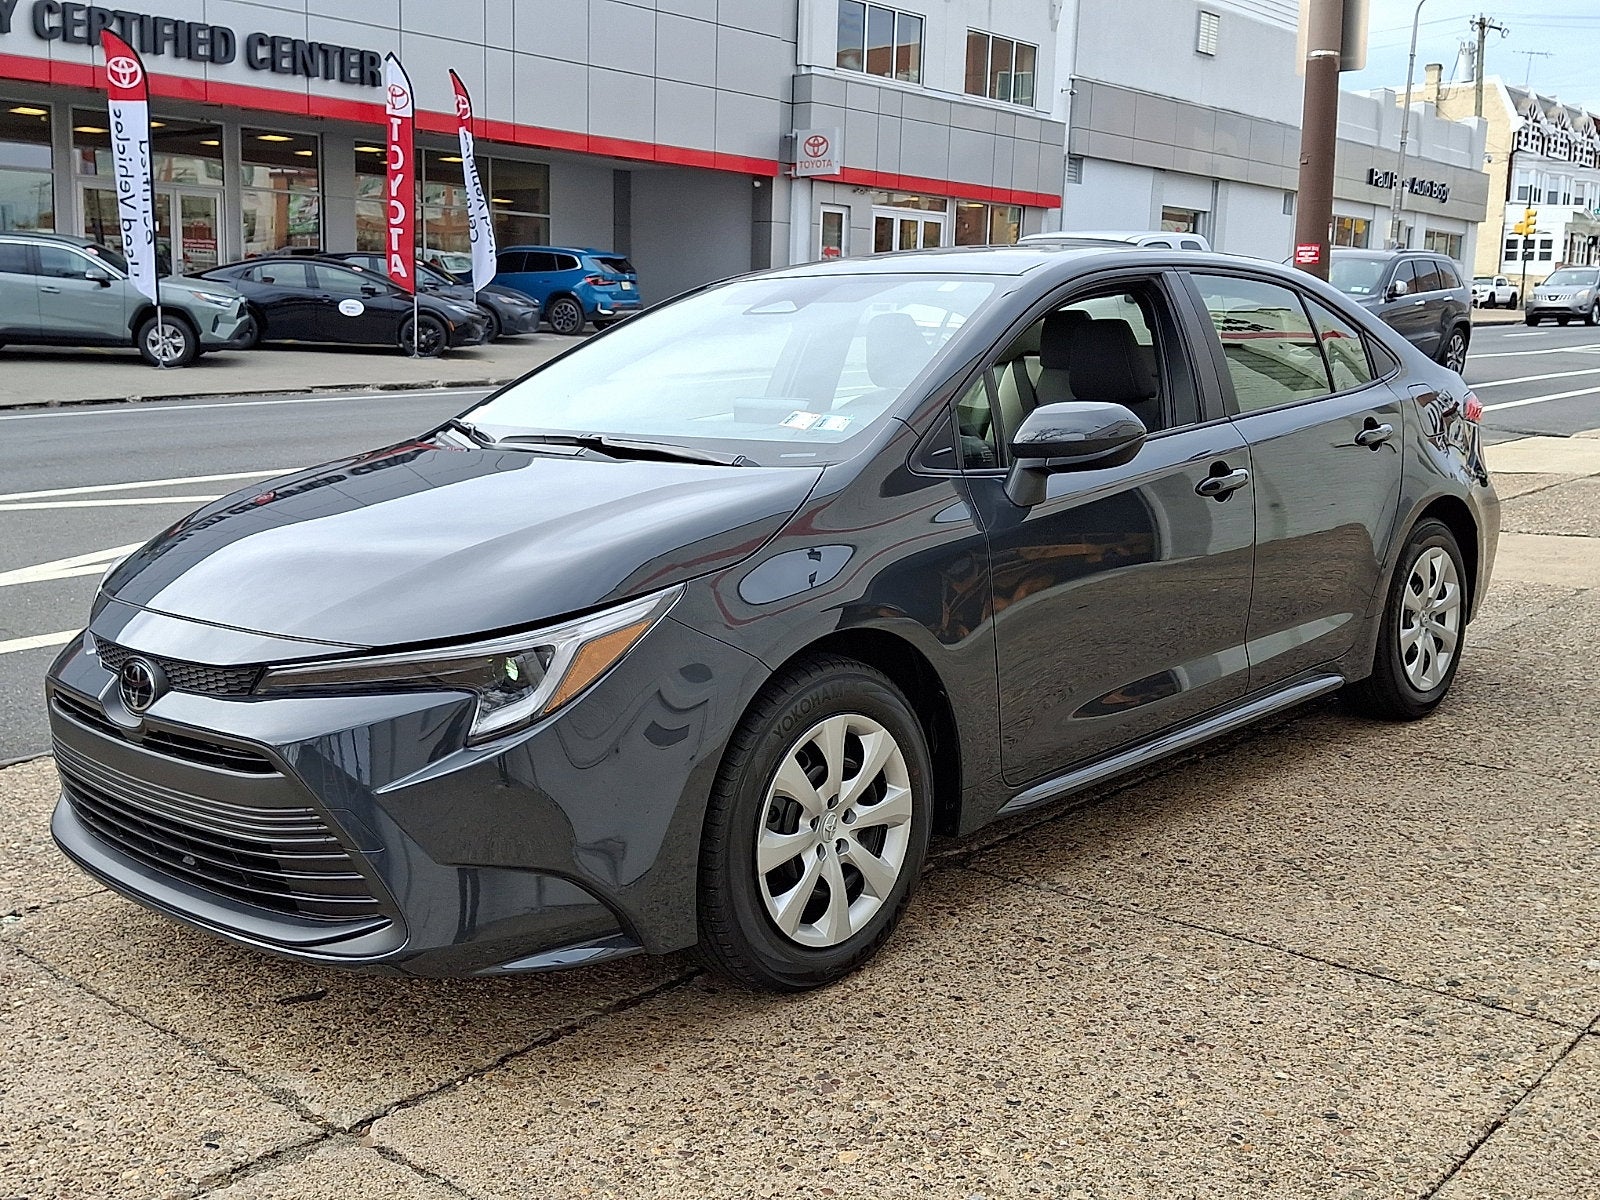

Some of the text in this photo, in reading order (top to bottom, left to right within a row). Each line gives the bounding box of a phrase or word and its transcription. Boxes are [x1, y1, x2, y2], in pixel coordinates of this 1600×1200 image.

[32, 0, 237, 64] CERTIFIED
[247, 32, 383, 87] CENTER
[799, 160, 833, 169] TOYOTA
[1368, 168, 1393, 190] Paul
[1431, 181, 1452, 204] Body
[390, 117, 408, 278] TOYOTA
[772, 682, 850, 739] YOKOHAM
